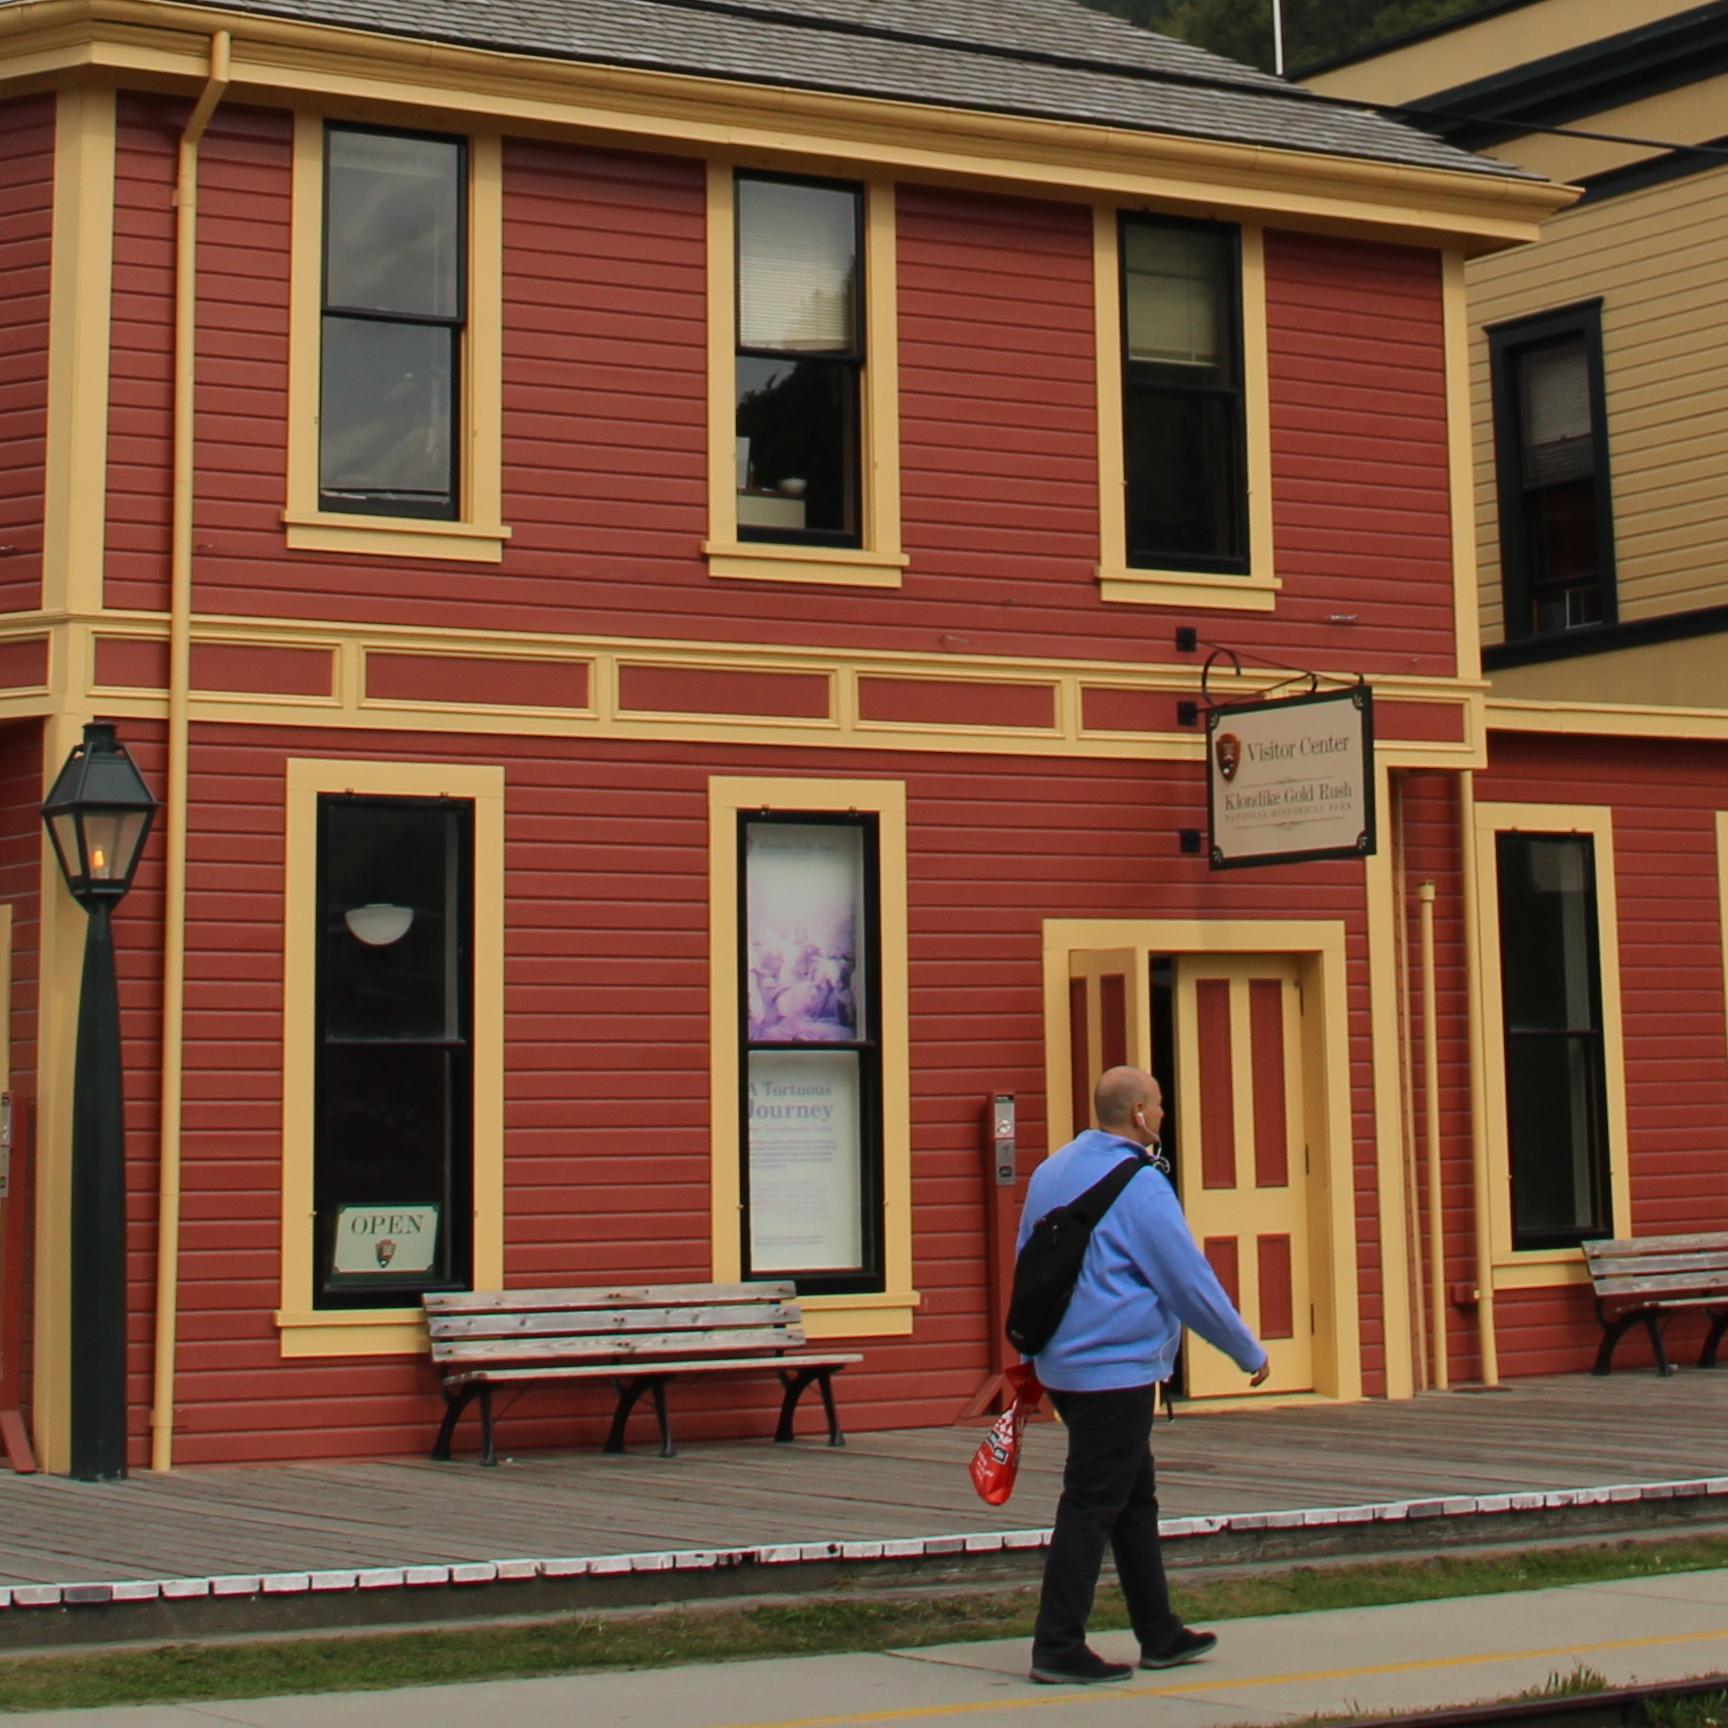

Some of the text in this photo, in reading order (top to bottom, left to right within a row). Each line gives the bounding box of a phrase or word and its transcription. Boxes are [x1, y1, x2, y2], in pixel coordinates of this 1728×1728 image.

[1247, 734, 1350, 762] Visitor Center
[1225, 781, 1352, 811] Klondike Gold Rush
[763, 1081, 832, 1097] Tortuous
[749, 1098, 833, 1122] Journey
[351, 1215, 425, 1234] OPEN
